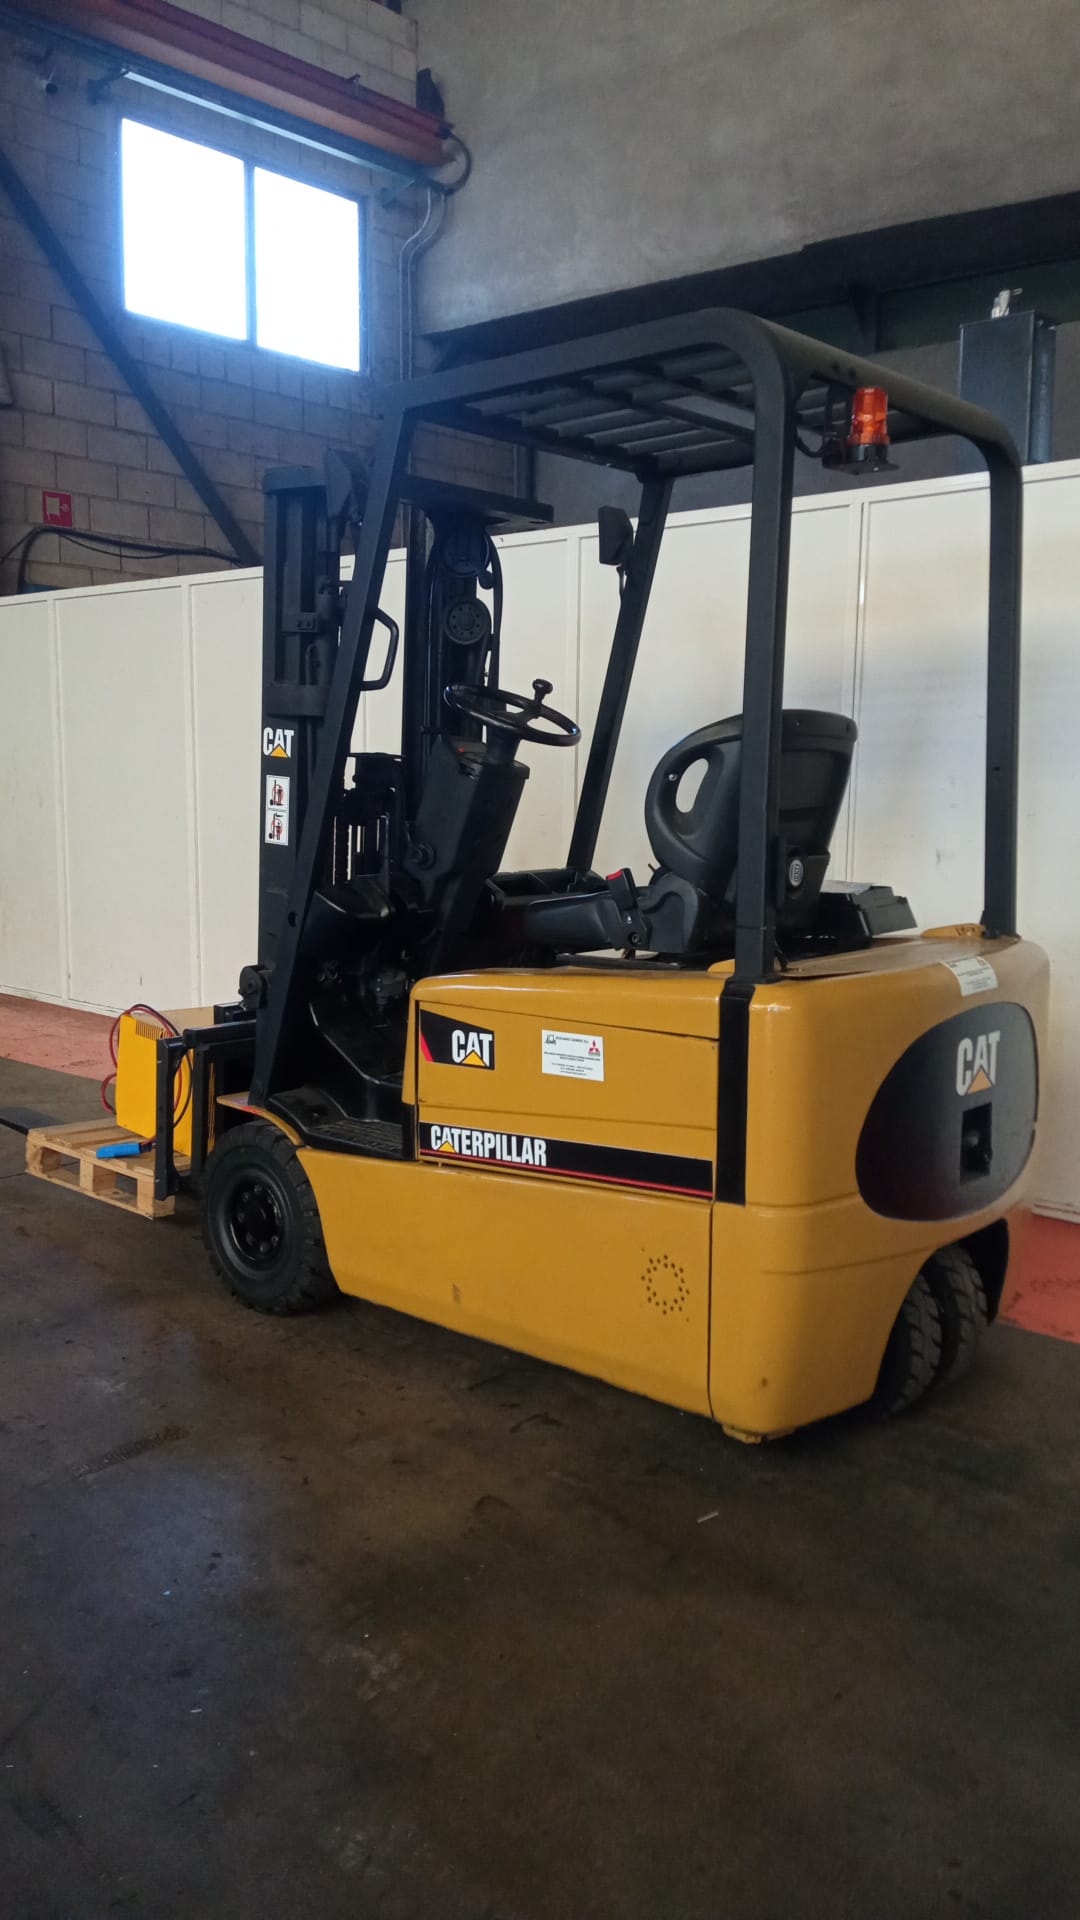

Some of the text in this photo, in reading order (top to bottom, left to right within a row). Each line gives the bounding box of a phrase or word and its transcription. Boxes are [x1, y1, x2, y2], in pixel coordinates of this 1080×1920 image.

[263, 727, 294, 758] CAT
[452, 1029, 493, 1067] CAT
[956, 1031, 1001, 1096] CAT
[431, 1125, 547, 1166] CATERPILLAR
